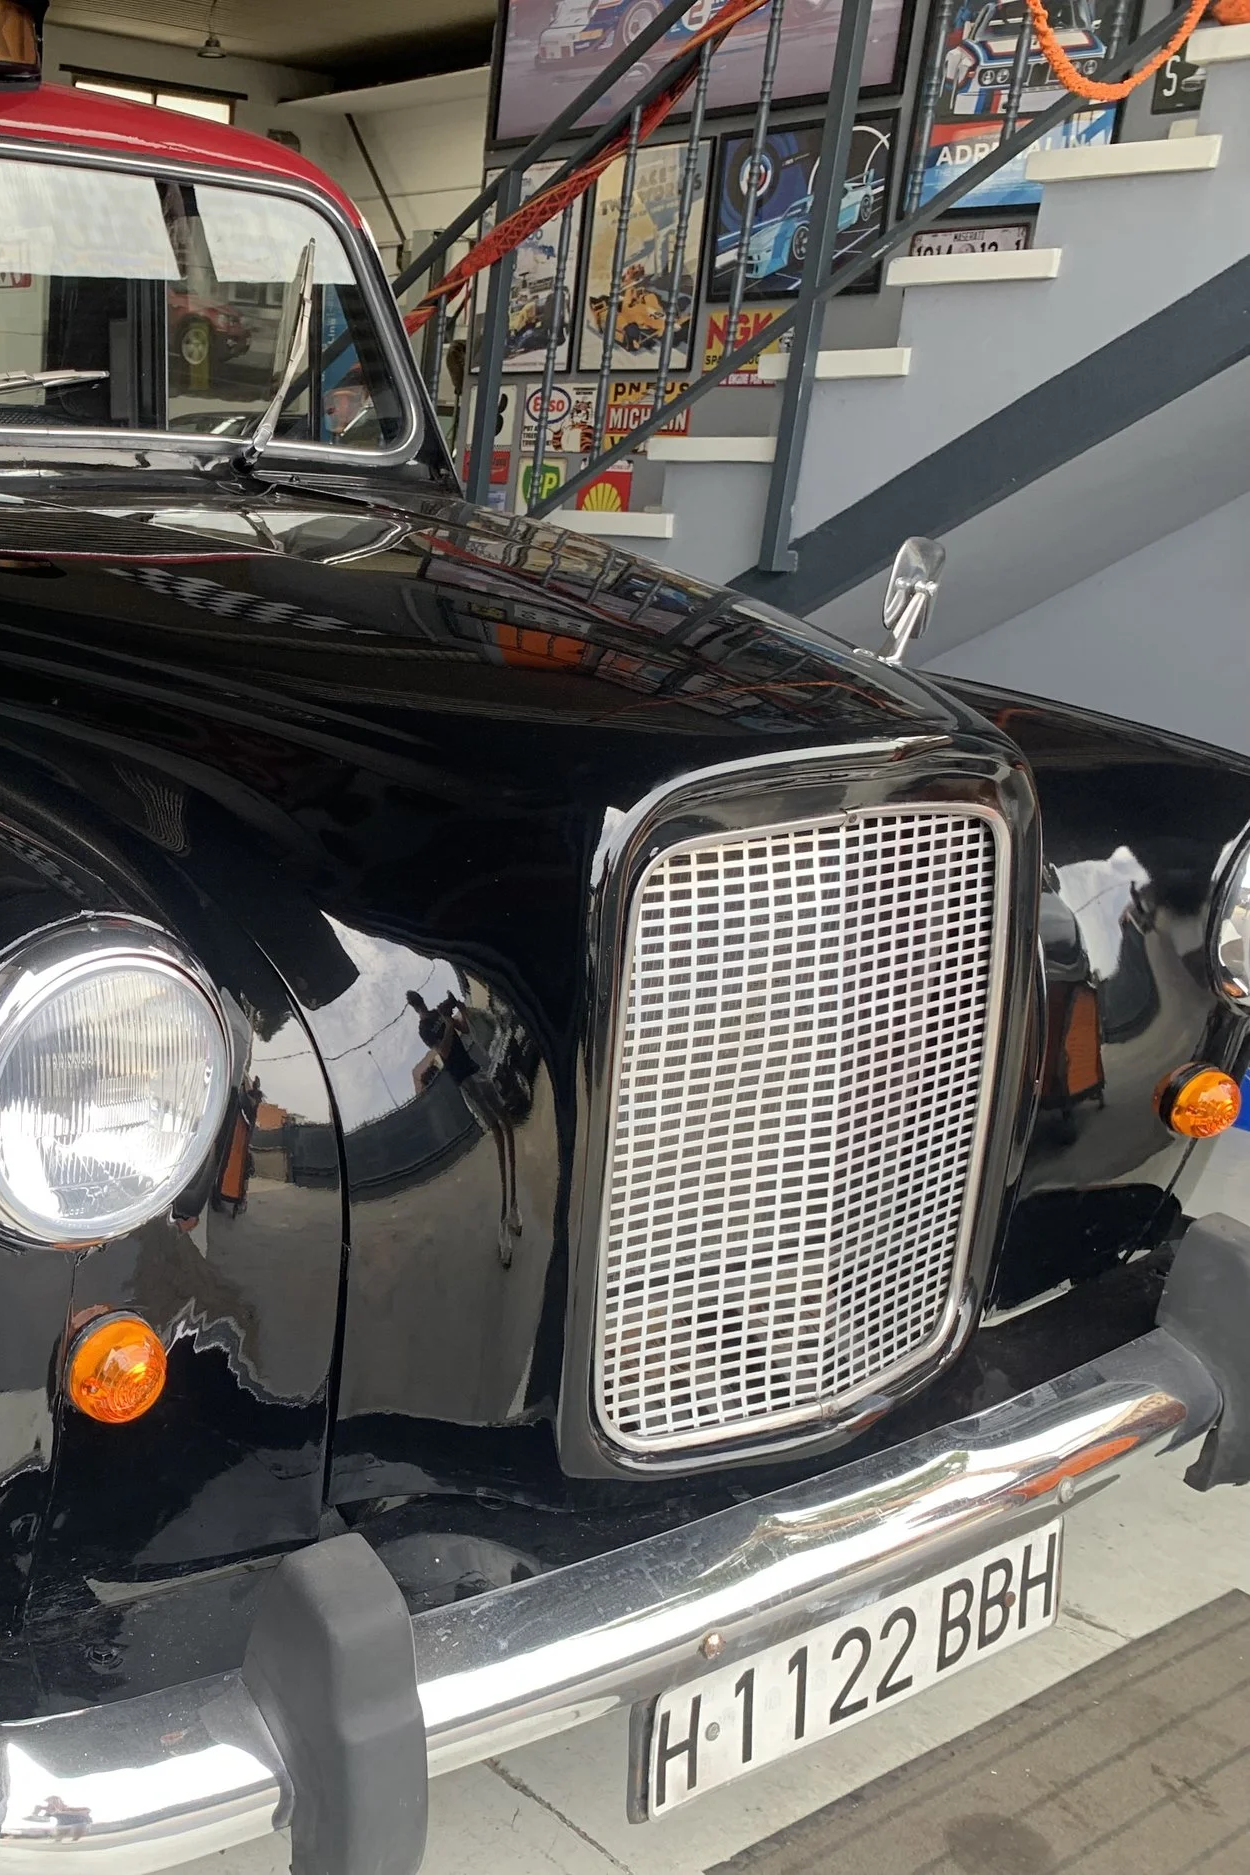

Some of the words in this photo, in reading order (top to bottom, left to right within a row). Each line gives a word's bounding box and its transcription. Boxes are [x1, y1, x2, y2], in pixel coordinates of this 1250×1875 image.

[706, 312, 774, 350] NGK
[532, 396, 566, 412] Eso
[656, 1694, 702, 1808] H
[734, 1606, 917, 1764] 1122
[936, 1532, 1057, 1673] BBH
